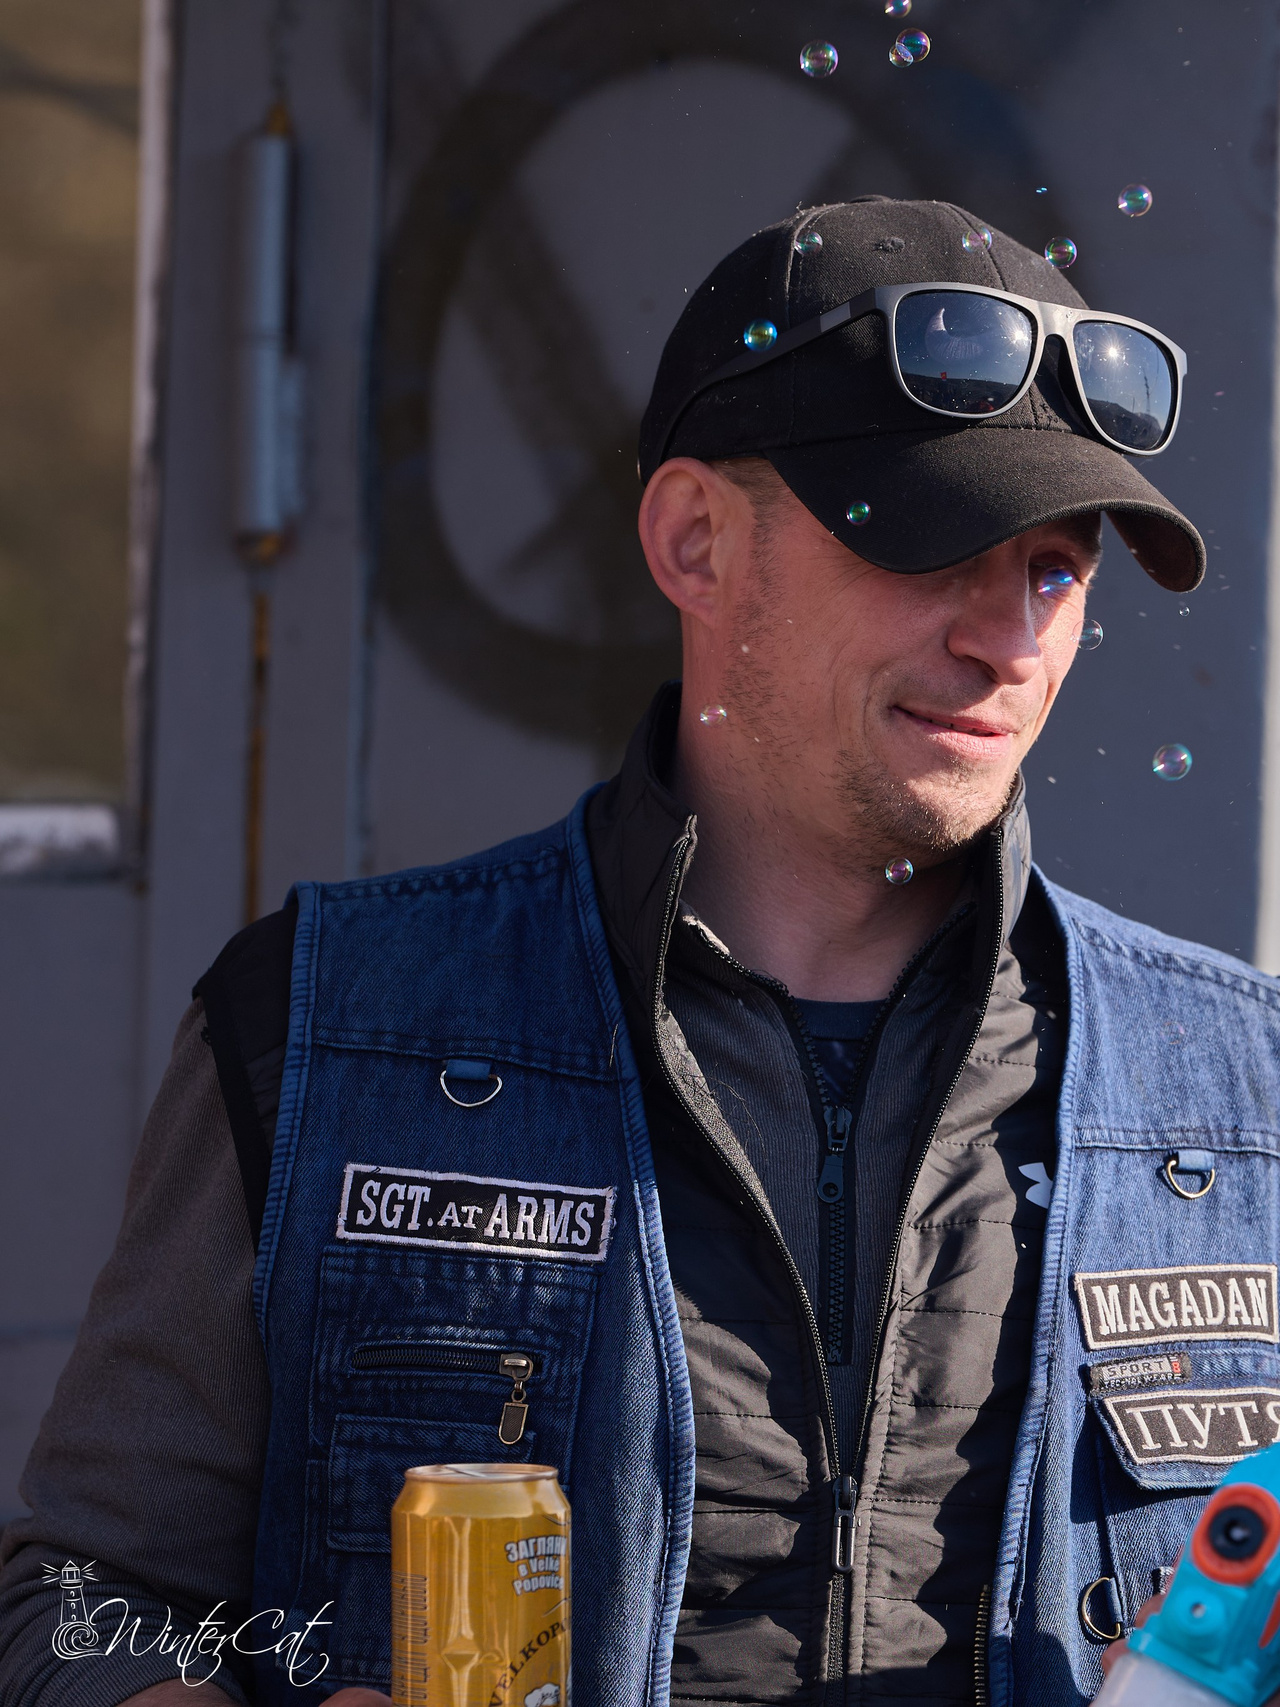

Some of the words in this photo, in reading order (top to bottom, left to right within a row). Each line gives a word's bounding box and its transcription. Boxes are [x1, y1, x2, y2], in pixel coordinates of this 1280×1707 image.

[356, 1179, 433, 1231] SGT.
[437, 1202, 482, 1229] AT
[484, 1193, 595, 1246] ARMS
[1091, 1277, 1269, 1335] MAGADAN
[1107, 1360, 1164, 1378] SPORT
